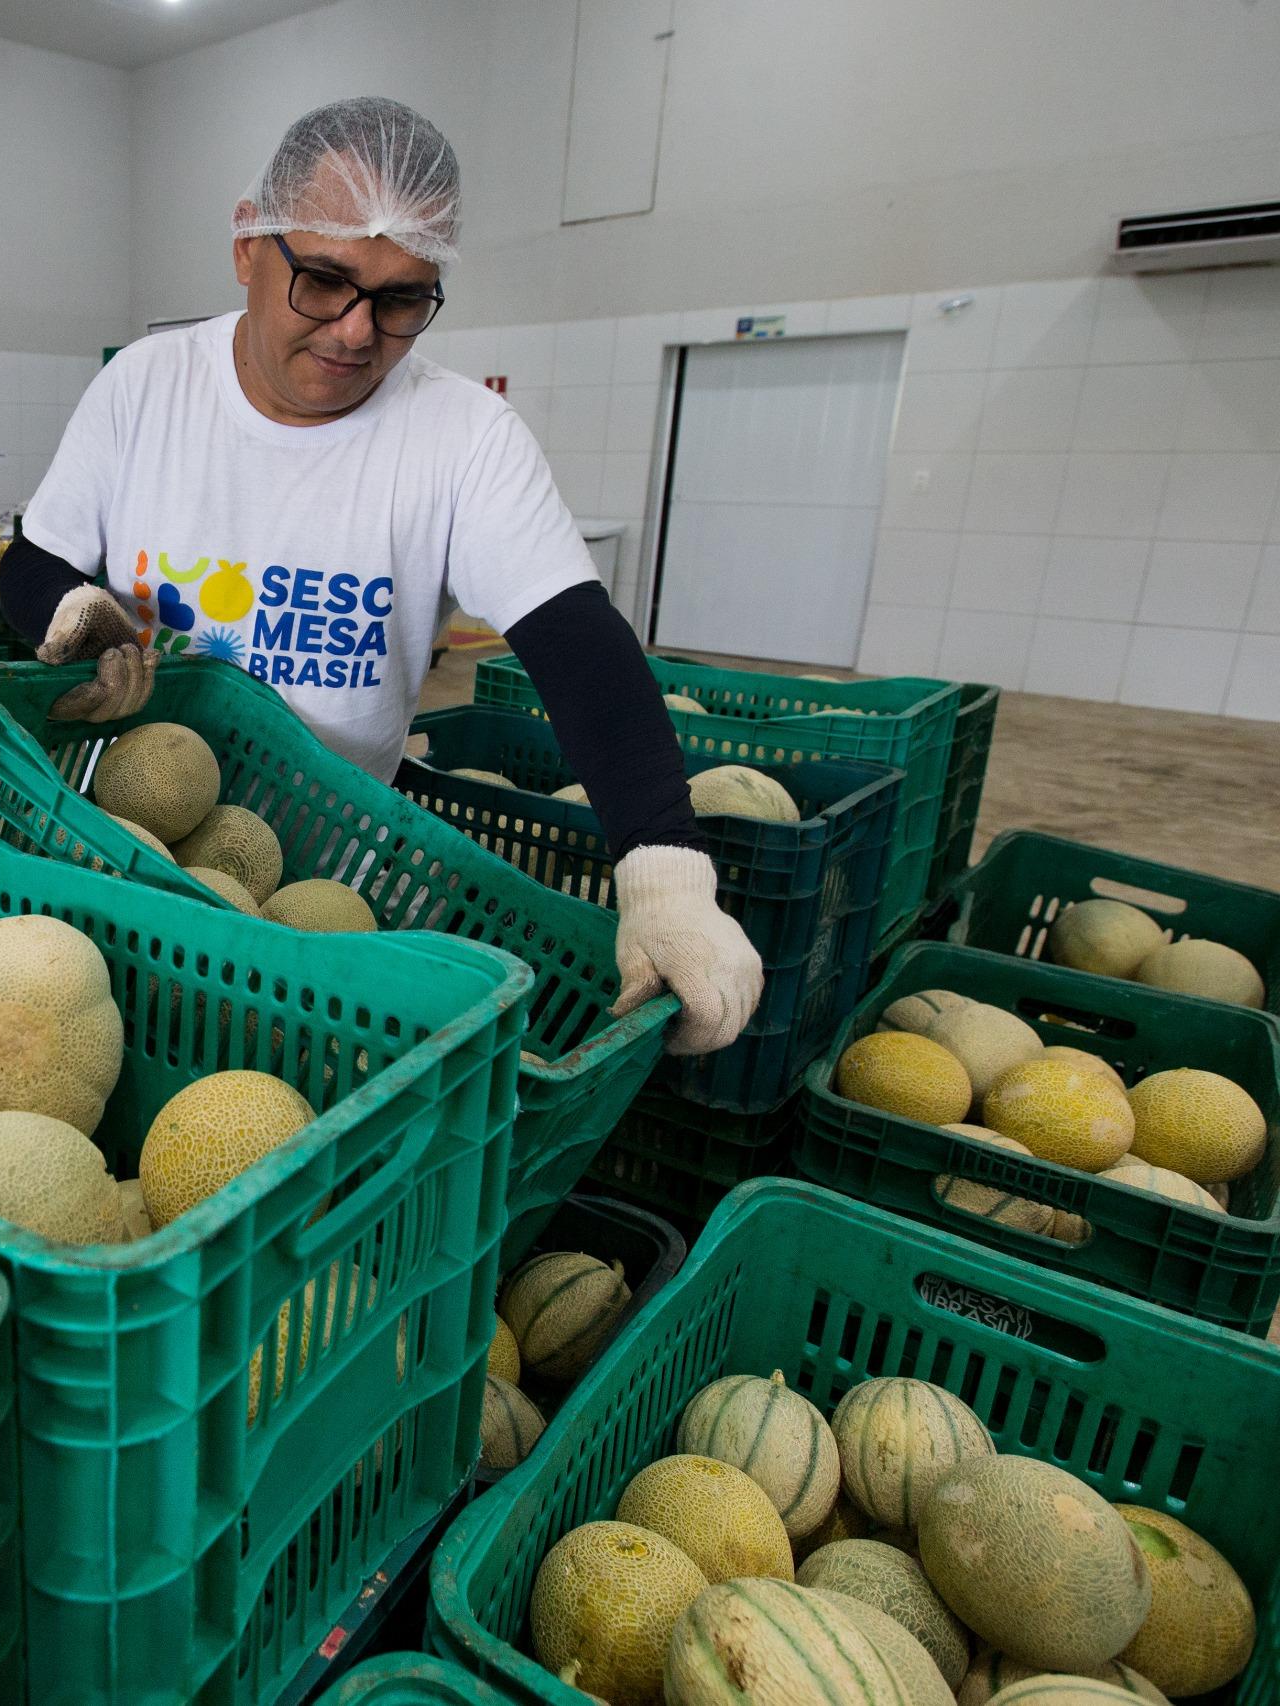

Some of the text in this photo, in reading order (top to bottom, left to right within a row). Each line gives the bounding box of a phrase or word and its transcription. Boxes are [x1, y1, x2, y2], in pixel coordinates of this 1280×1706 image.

[259, 565, 393, 617] SESC
[252, 609, 387, 656] MESA
[249, 653, 382, 688] BRASIL
[935, 1281, 1015, 1323] MESA
